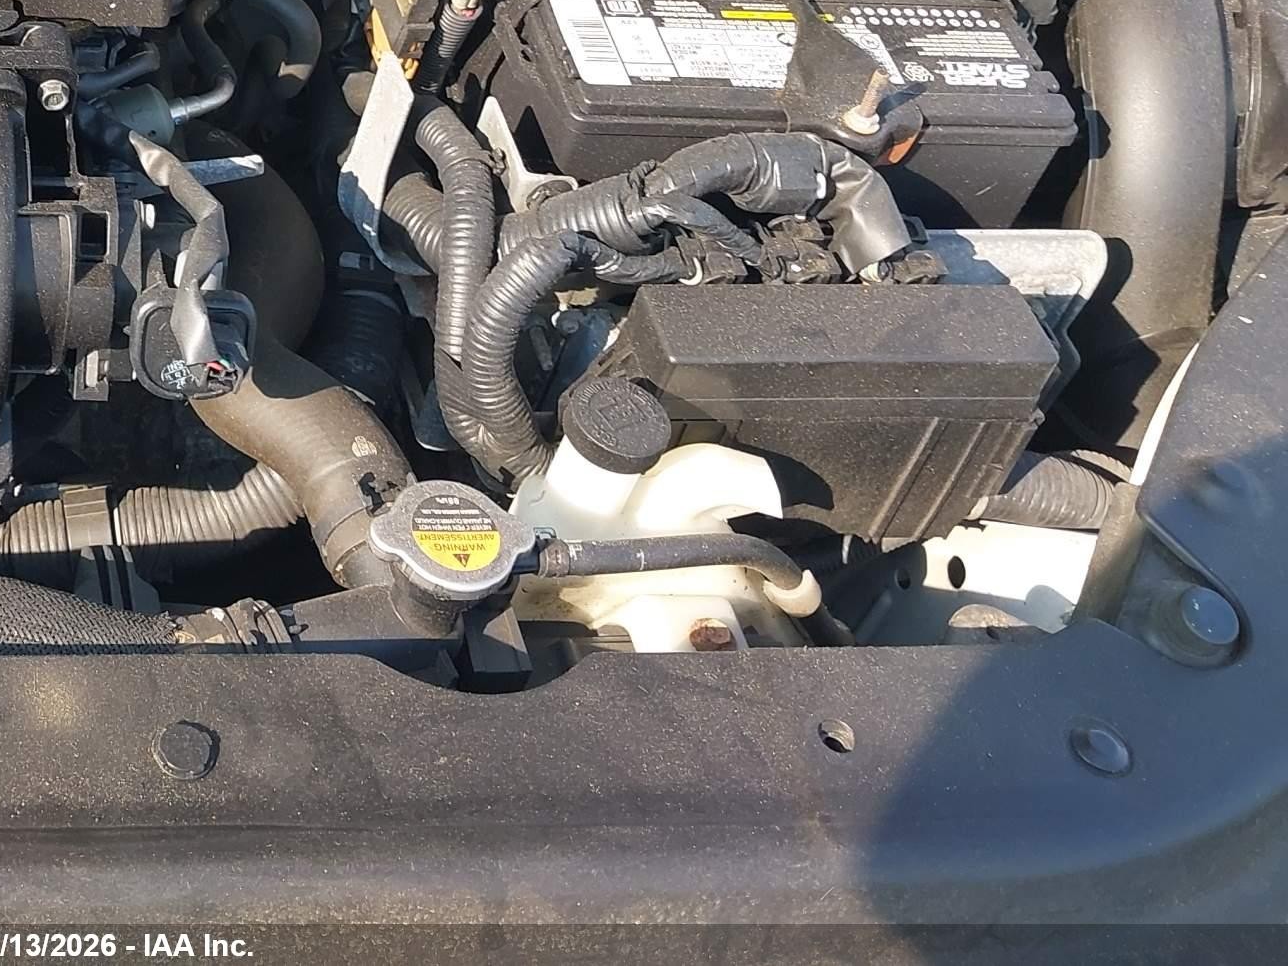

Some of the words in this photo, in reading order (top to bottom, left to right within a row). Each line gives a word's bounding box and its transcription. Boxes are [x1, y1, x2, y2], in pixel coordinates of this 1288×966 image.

[942, 61, 1030, 79] START
[943, 73, 1028, 89] SUPER
[434, 543, 487, 552] WARNING
